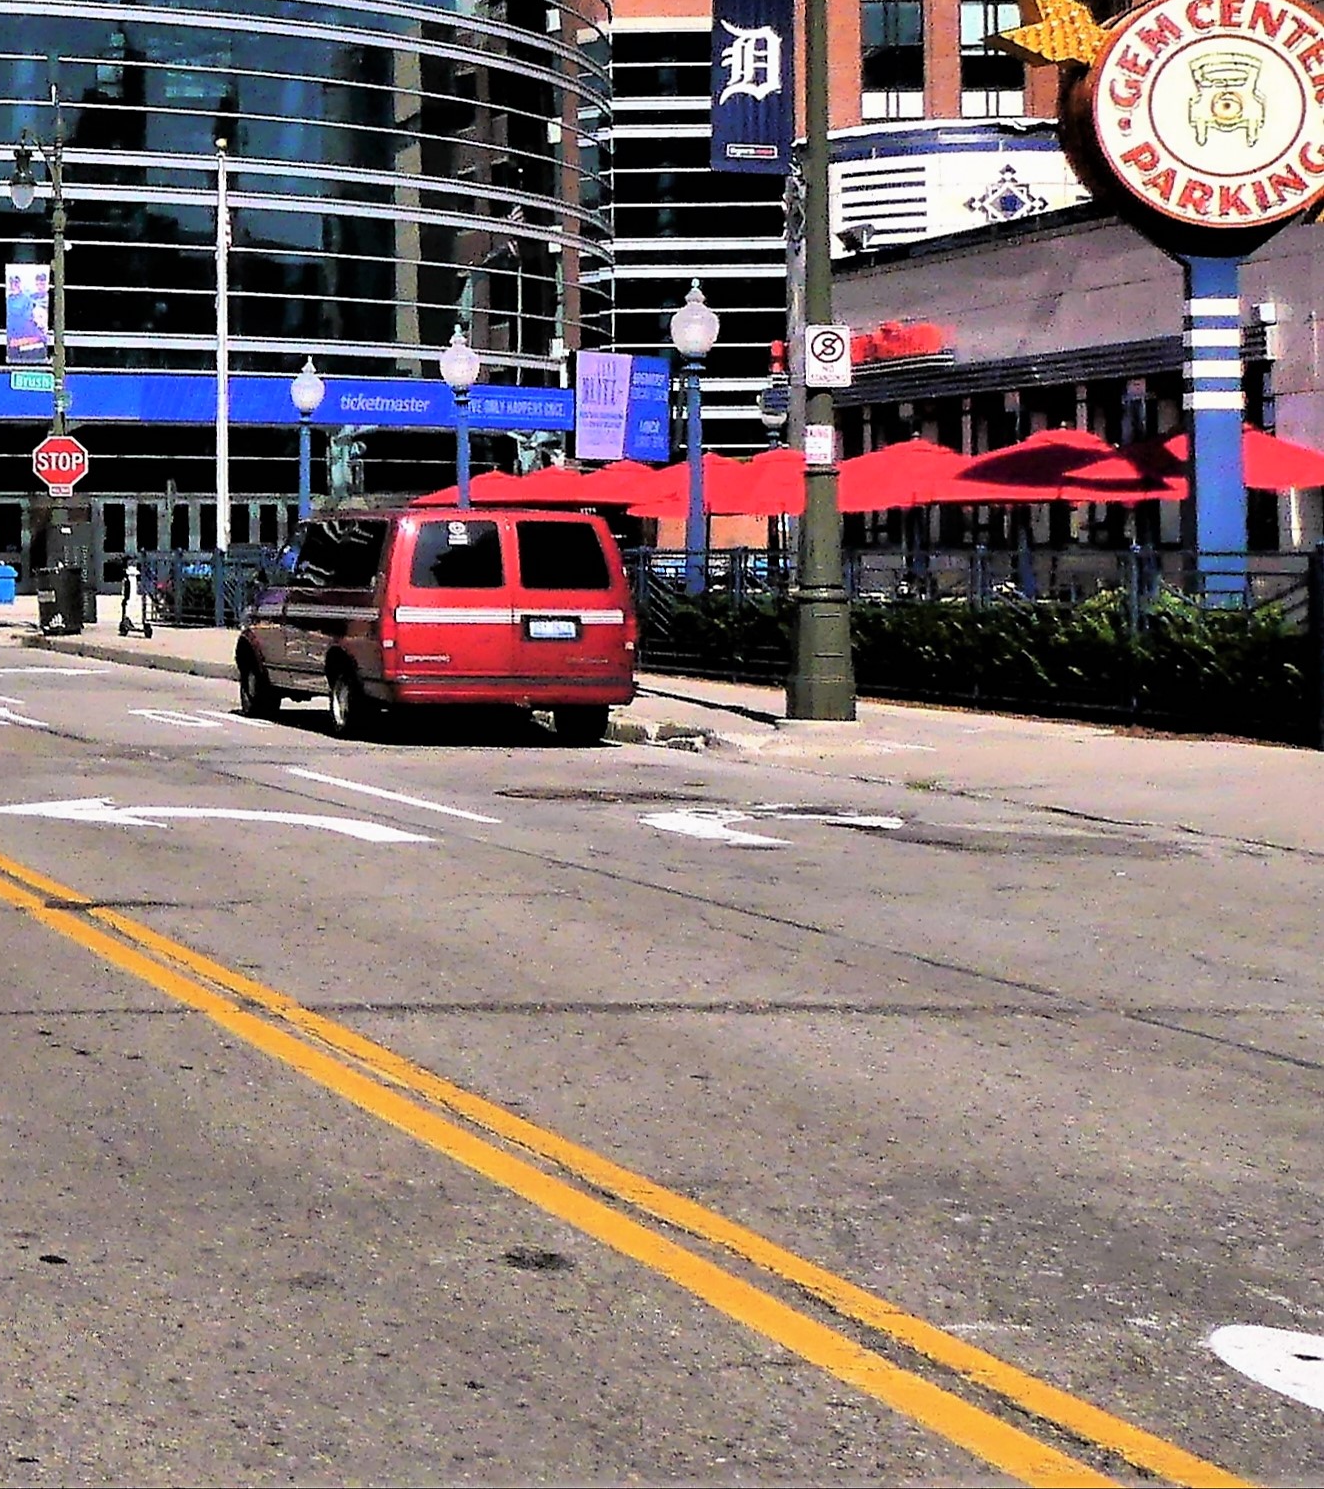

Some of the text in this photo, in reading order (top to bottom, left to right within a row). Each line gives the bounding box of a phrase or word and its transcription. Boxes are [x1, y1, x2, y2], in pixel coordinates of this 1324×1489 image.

[719, 19, 782, 105] D
[1109, 13, 1184, 109] GEM
[1120, 141, 1324, 218] PARKING
[15, 374, 51, 389] Brush
[340, 392, 431, 413] ticketmaster
[36, 452, 84, 472] STOP
